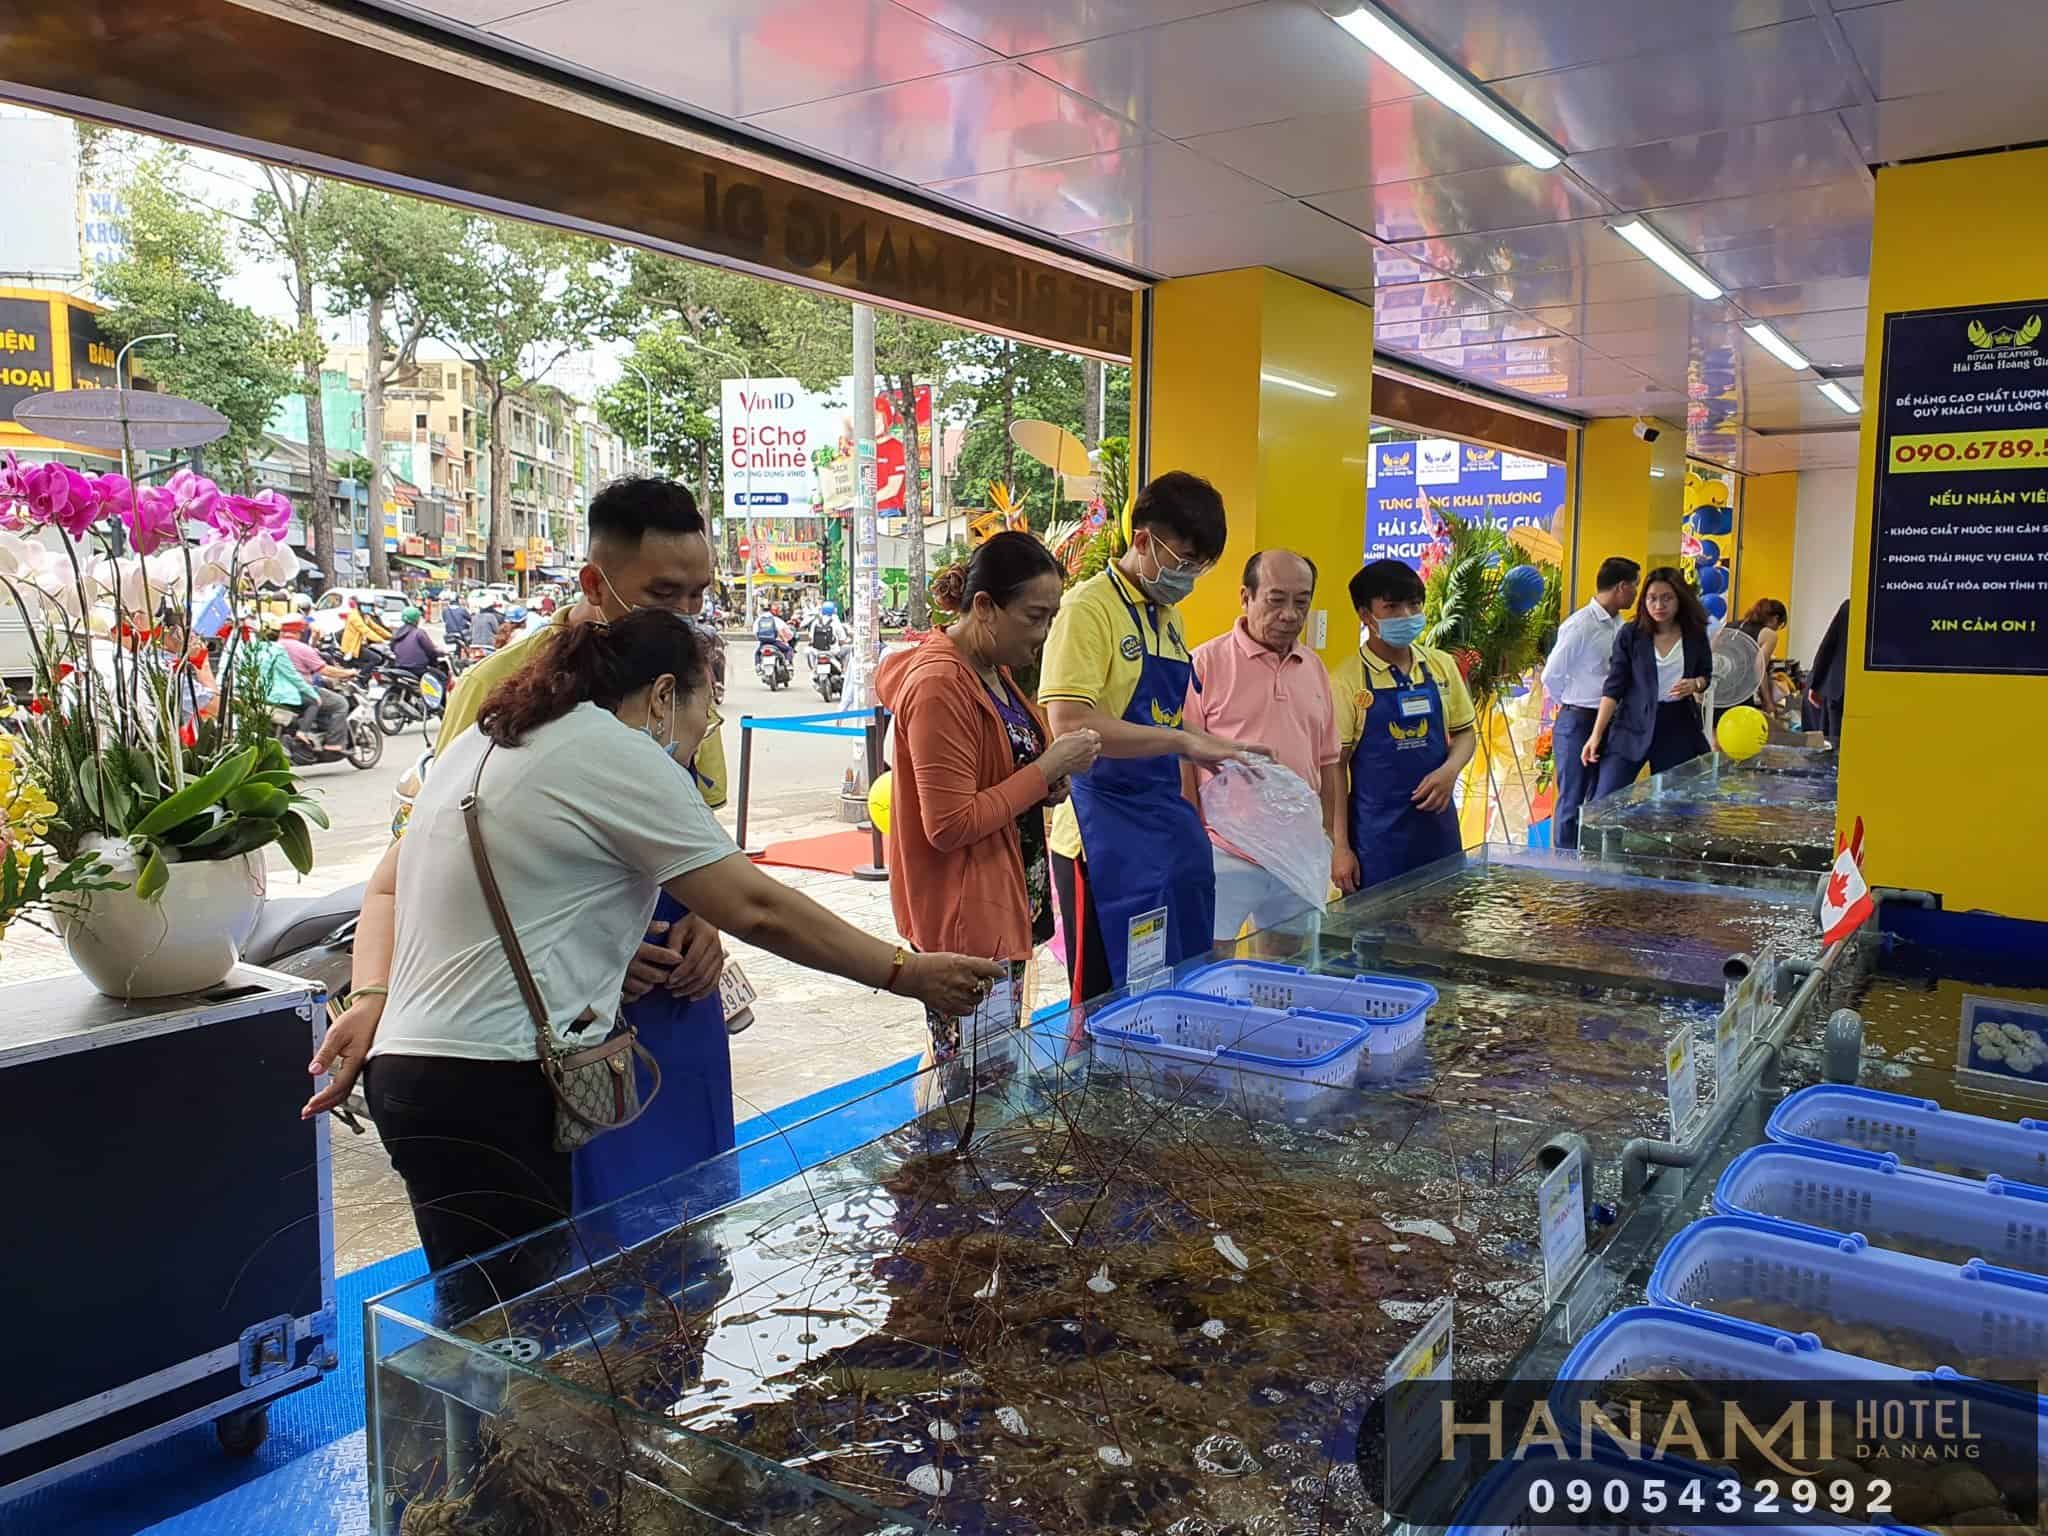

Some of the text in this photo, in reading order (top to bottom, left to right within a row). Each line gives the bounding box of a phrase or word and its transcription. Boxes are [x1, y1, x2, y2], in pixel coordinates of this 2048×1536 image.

[739, 391, 795, 413] VinID
[1949, 393, 1975, 404] CAO
[1985, 404, 2005, 413] VUI
[731, 447, 807, 468] Online
[1453, 494, 1483, 507] KHAI
[1929, 489, 1962, 506] NẾU
[1966, 489, 2015, 505] NHÂN
[1890, 526, 1928, 536] KHÔNG
[1995, 525, 2014, 534] KHI
[1888, 554, 1925, 563] PHONG
[1886, 580, 1924, 590] KHÔNG
[1930, 619, 1958, 631] XIN
[2001, 619, 2026, 631] ƠN
